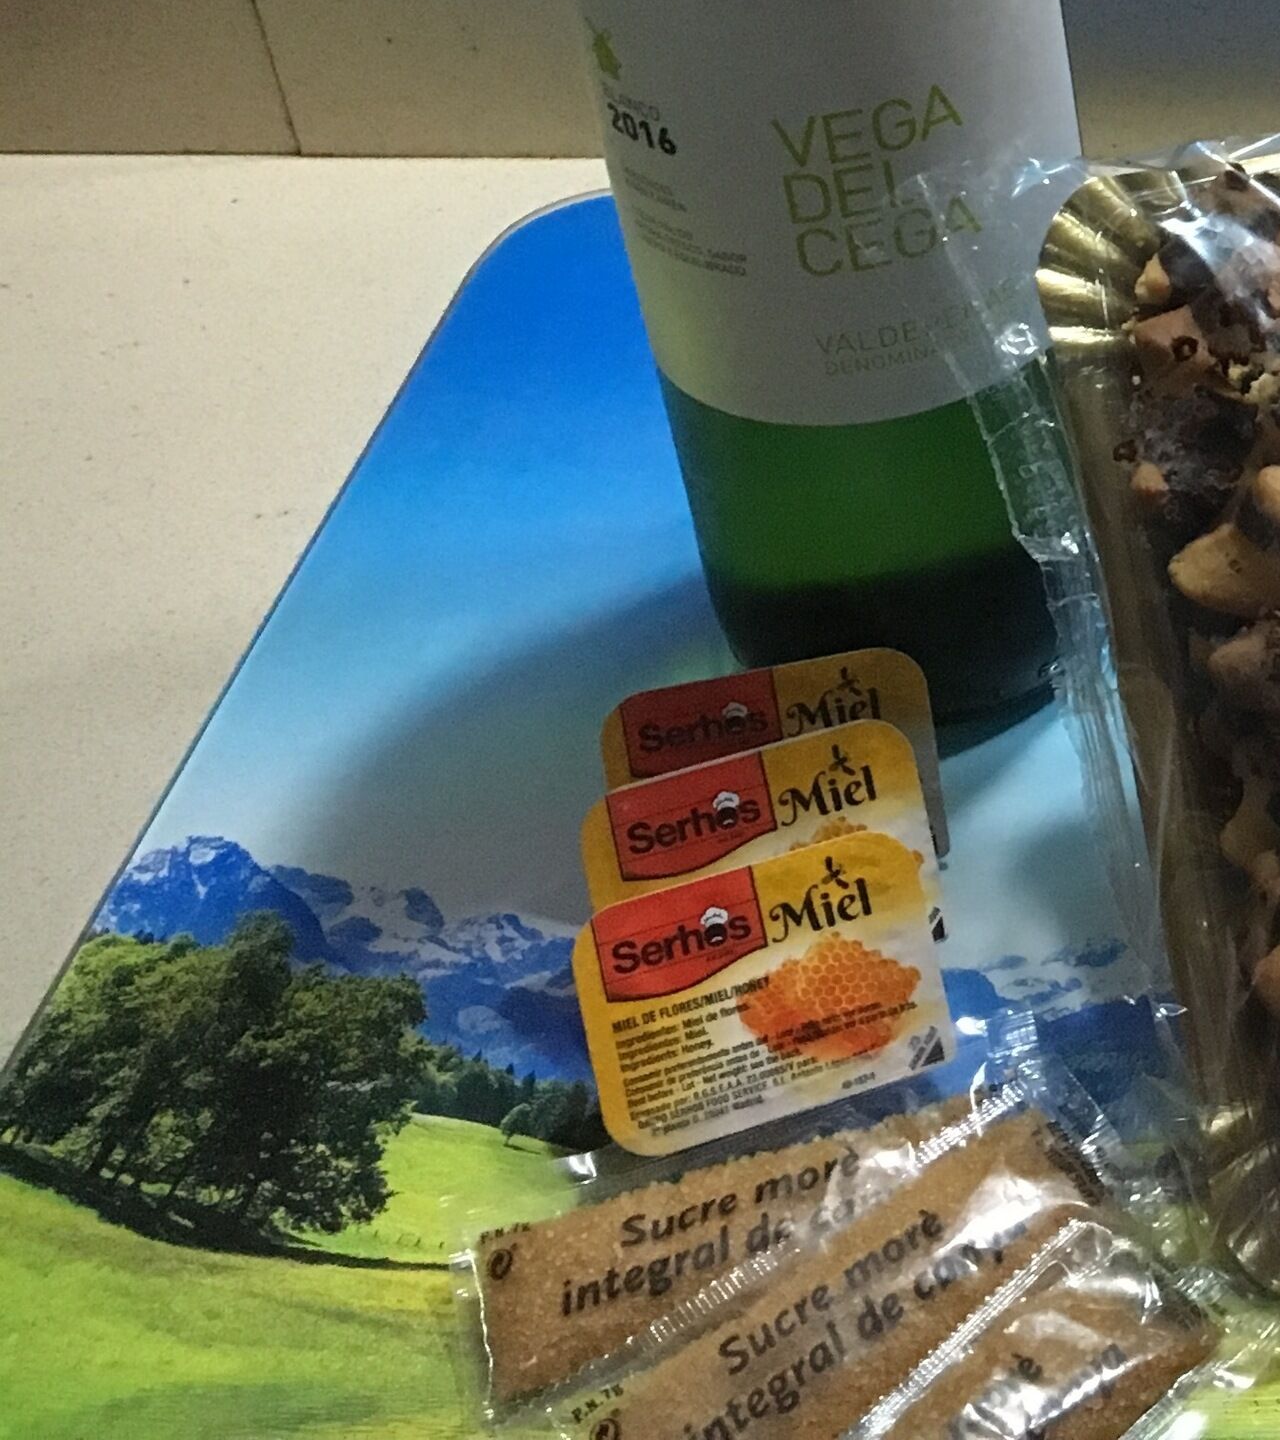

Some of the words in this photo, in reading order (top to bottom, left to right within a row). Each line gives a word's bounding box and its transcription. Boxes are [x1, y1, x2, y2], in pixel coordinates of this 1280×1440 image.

[607, 101, 677, 156] 2016
[771, 83, 963, 168] VEGA
[783, 160, 917, 224] DEL
[796, 196, 983, 278] CEGA
[785, 680, 881, 737] Miel
[628, 796, 759, 852] Serhos
[777, 761, 877, 824] Miel
[612, 912, 750, 972] Serhos
[767, 874, 872, 940] Miel
[610, 1014, 639, 1033] MIEL
[640, 1009, 657, 1024] DE
[620, 1191, 737, 1247] Sucre
[561, 1225, 730, 1317] integral
[745, 1212, 797, 1254] de
[718, 1283, 832, 1376] Sucre
[857, 1291, 905, 1341] de
